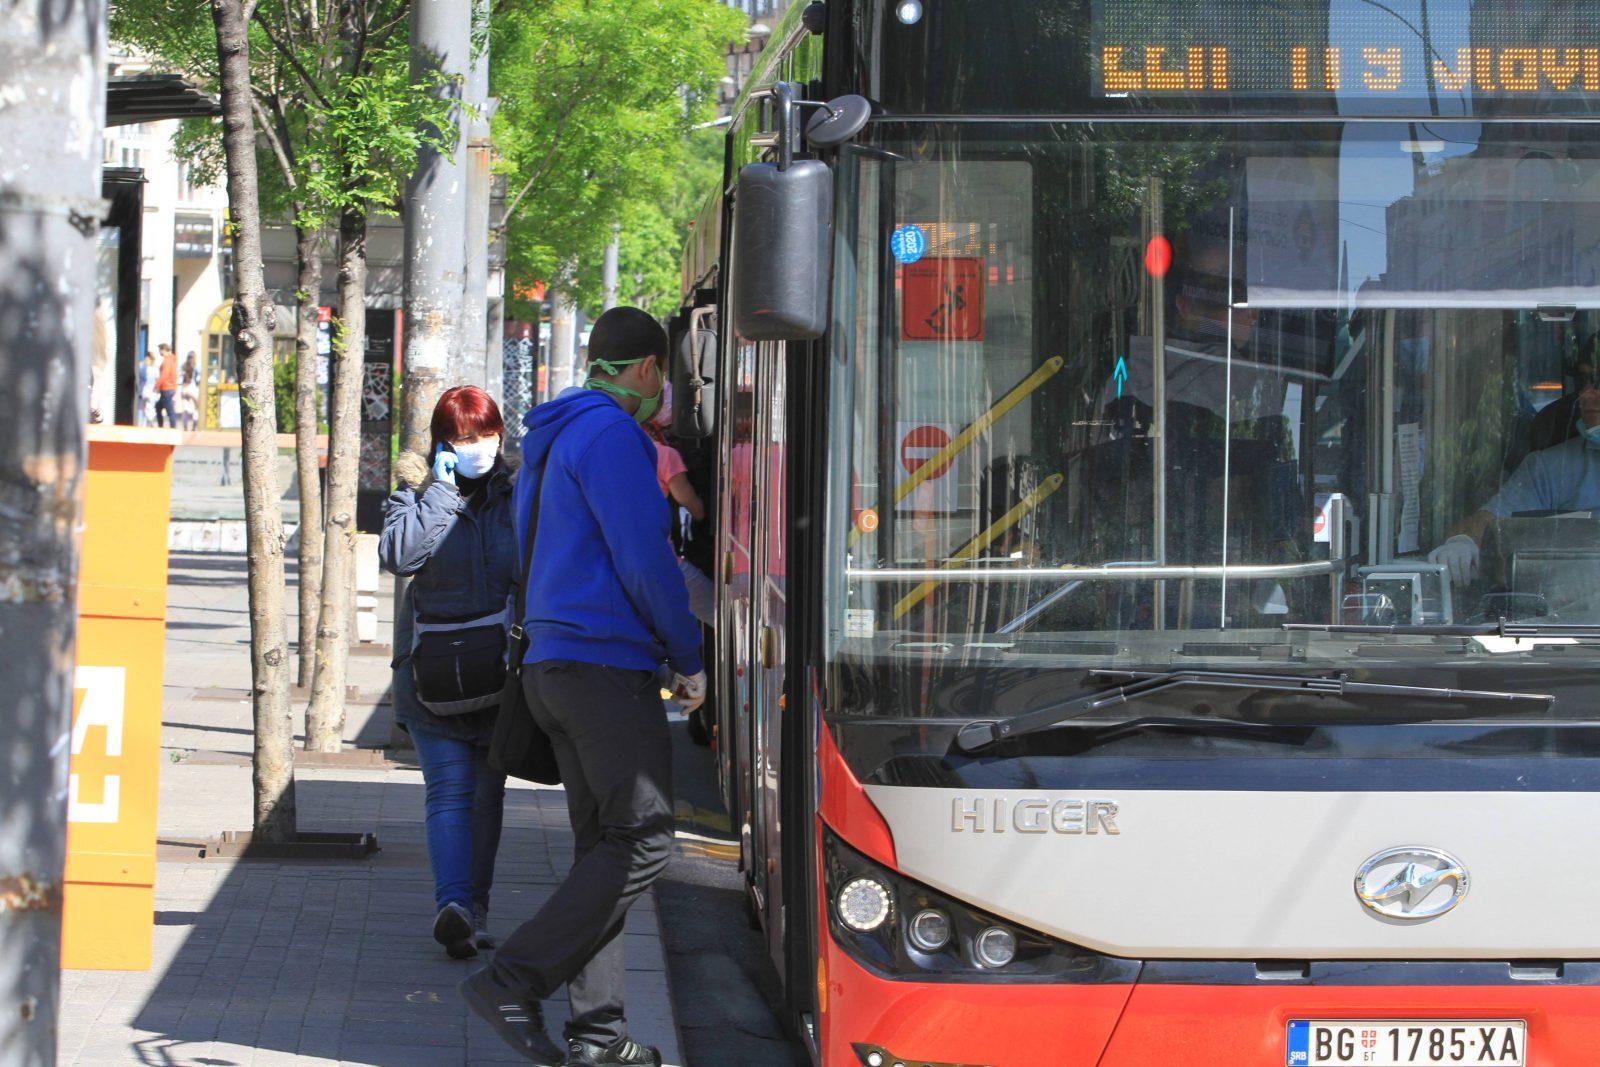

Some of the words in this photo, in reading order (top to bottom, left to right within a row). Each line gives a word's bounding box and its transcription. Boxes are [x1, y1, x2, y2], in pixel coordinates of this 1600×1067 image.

[905, 231, 918, 254] 2020
[951, 796, 1121, 835] HIGER
[1290, 1051, 1308, 1061] SRB
[1315, 1027, 1355, 1062] BG
